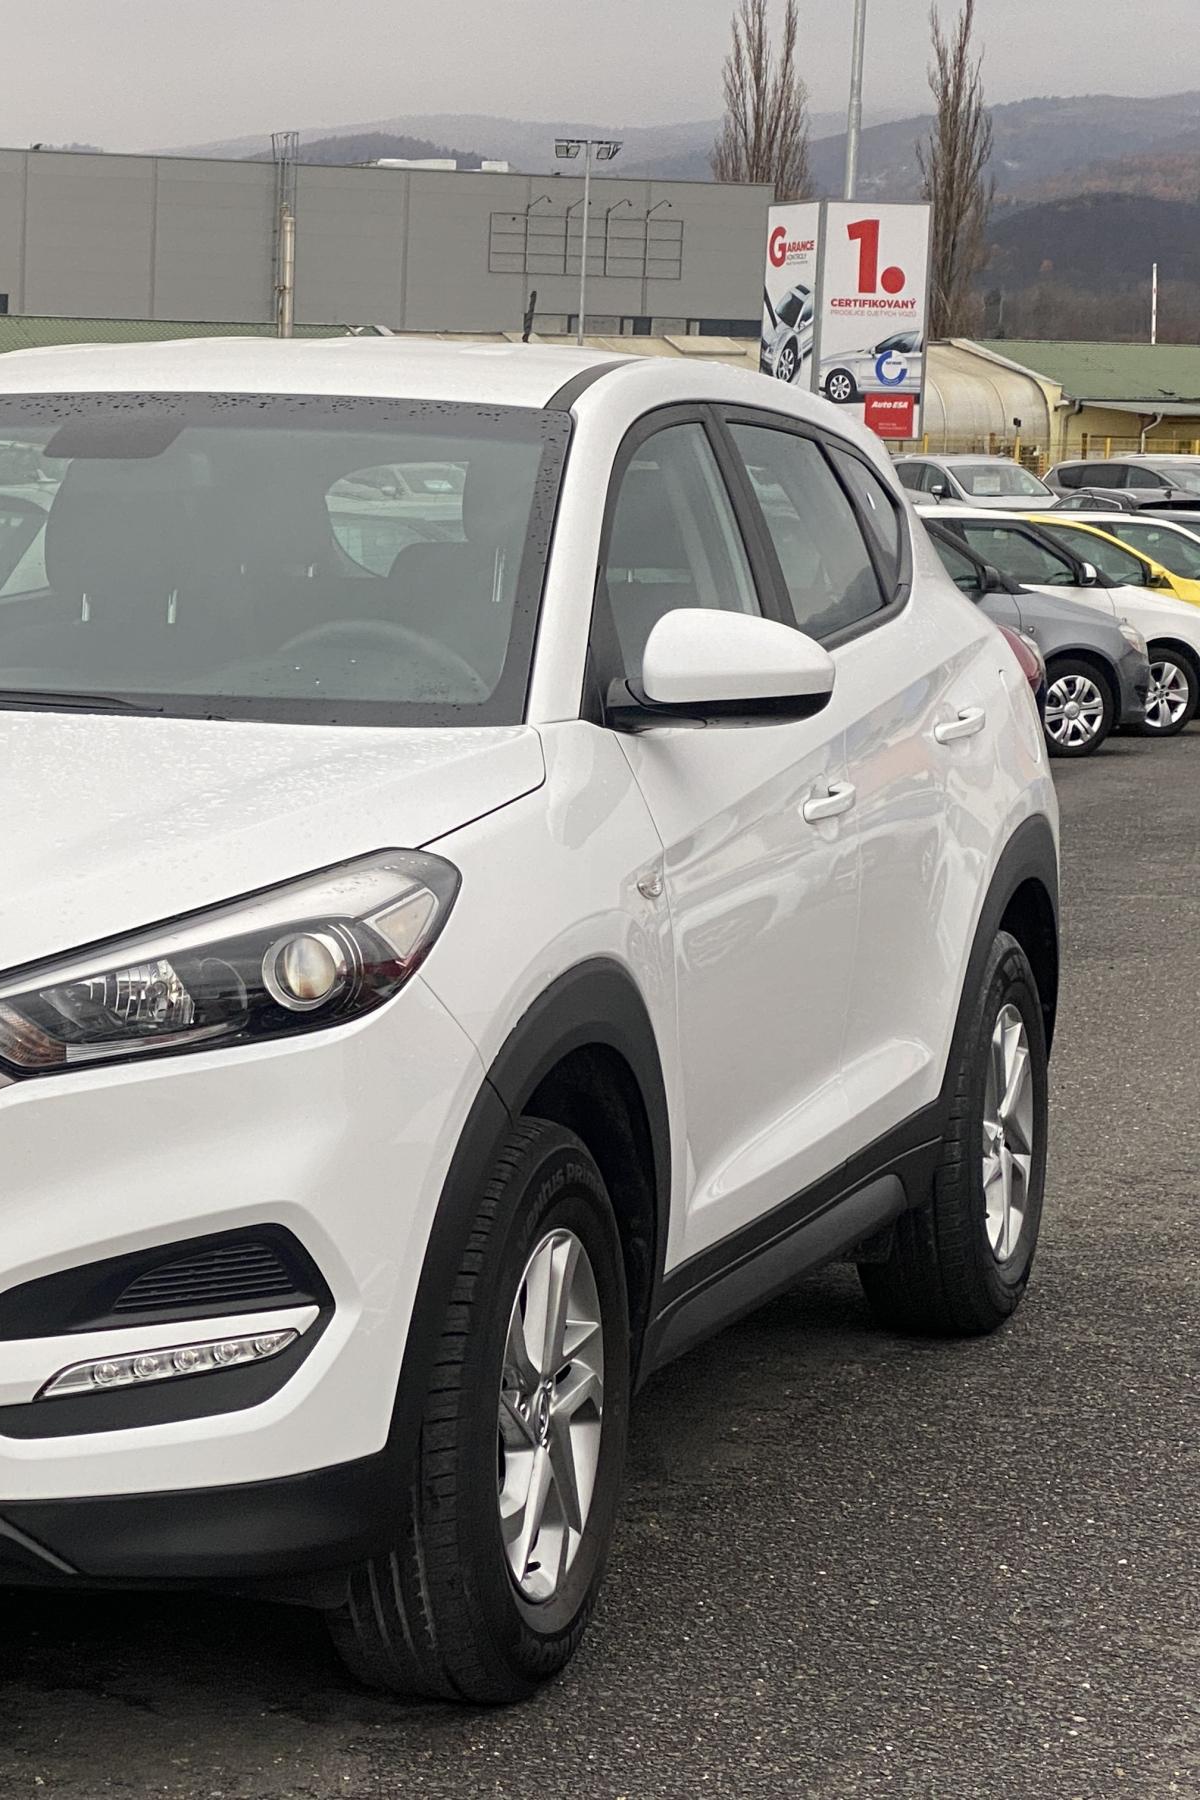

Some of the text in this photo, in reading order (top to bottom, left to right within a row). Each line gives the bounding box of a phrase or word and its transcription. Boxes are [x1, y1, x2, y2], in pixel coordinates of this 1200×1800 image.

[830, 297, 917, 309] CERTIFIKOVANÝ
[871, 400, 909, 409] Auto ESA
